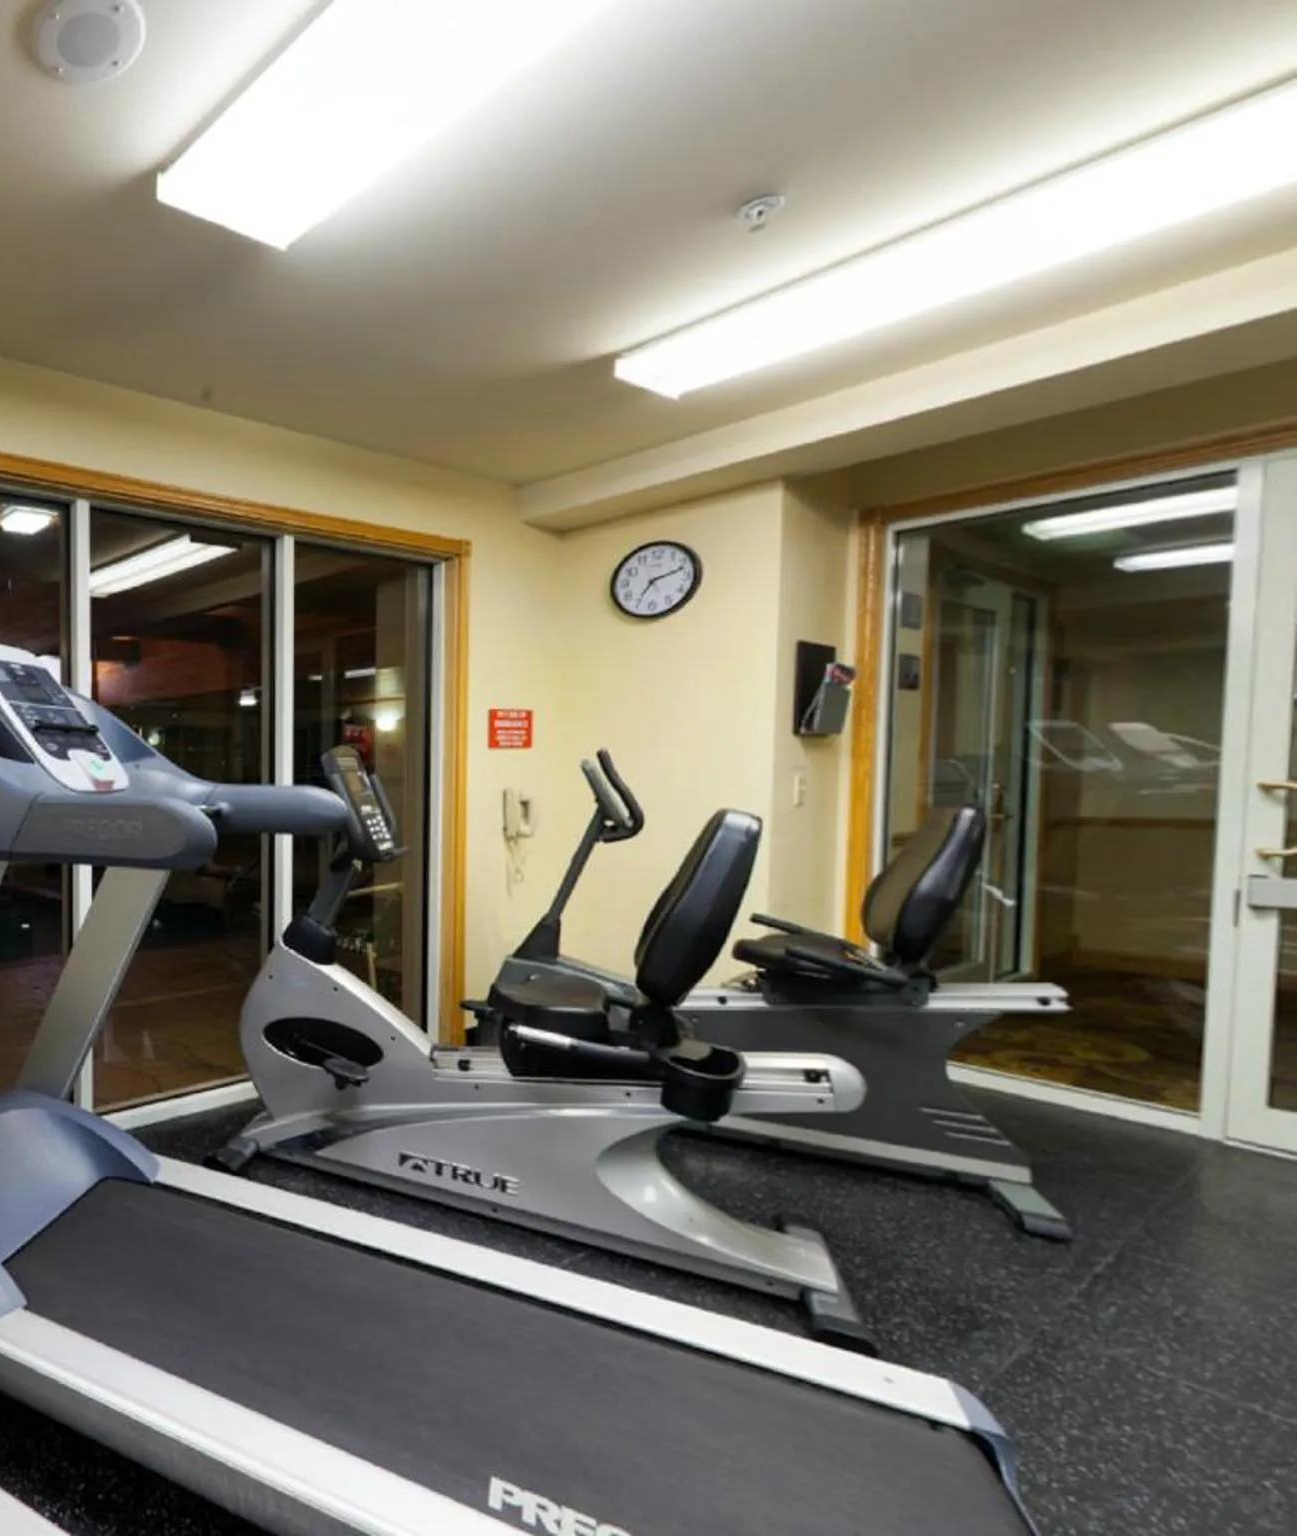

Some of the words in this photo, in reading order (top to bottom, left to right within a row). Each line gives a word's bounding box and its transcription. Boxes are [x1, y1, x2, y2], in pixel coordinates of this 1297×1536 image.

[637, 554, 647, 565] 11
[651, 549, 665, 560] 12
[627, 566, 638, 577] 10
[647, 600, 657, 611] 6
